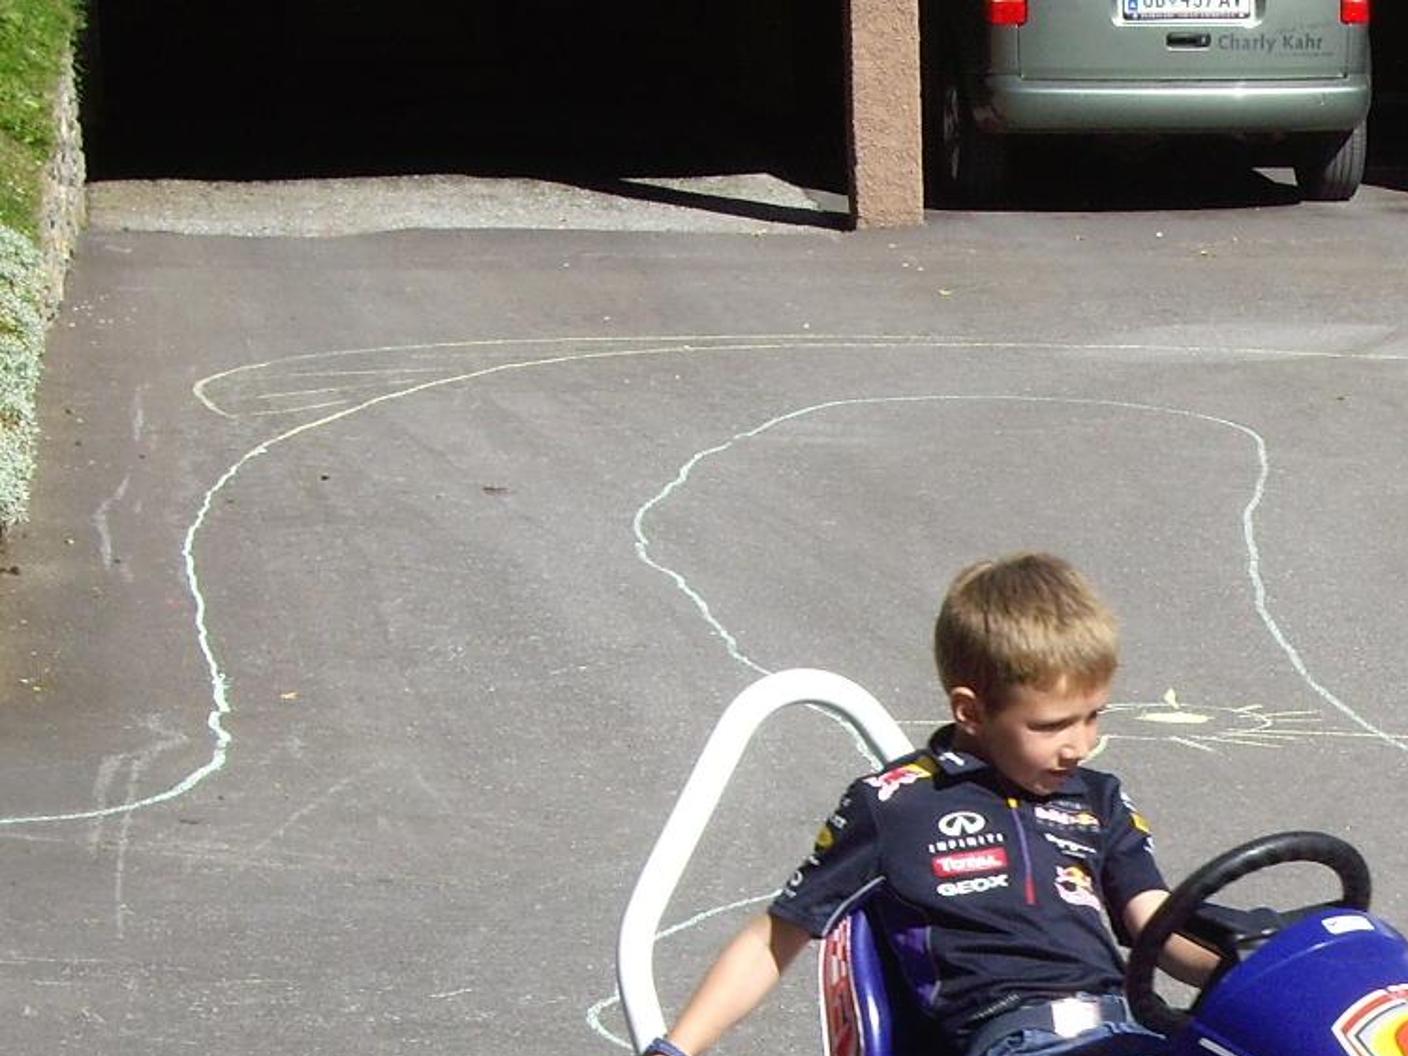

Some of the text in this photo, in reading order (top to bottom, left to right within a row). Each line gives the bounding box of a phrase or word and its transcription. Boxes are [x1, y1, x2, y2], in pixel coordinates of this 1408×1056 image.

[1218, 32, 1323, 53] Charly Kahr
[937, 873, 1009, 896] GEOX
